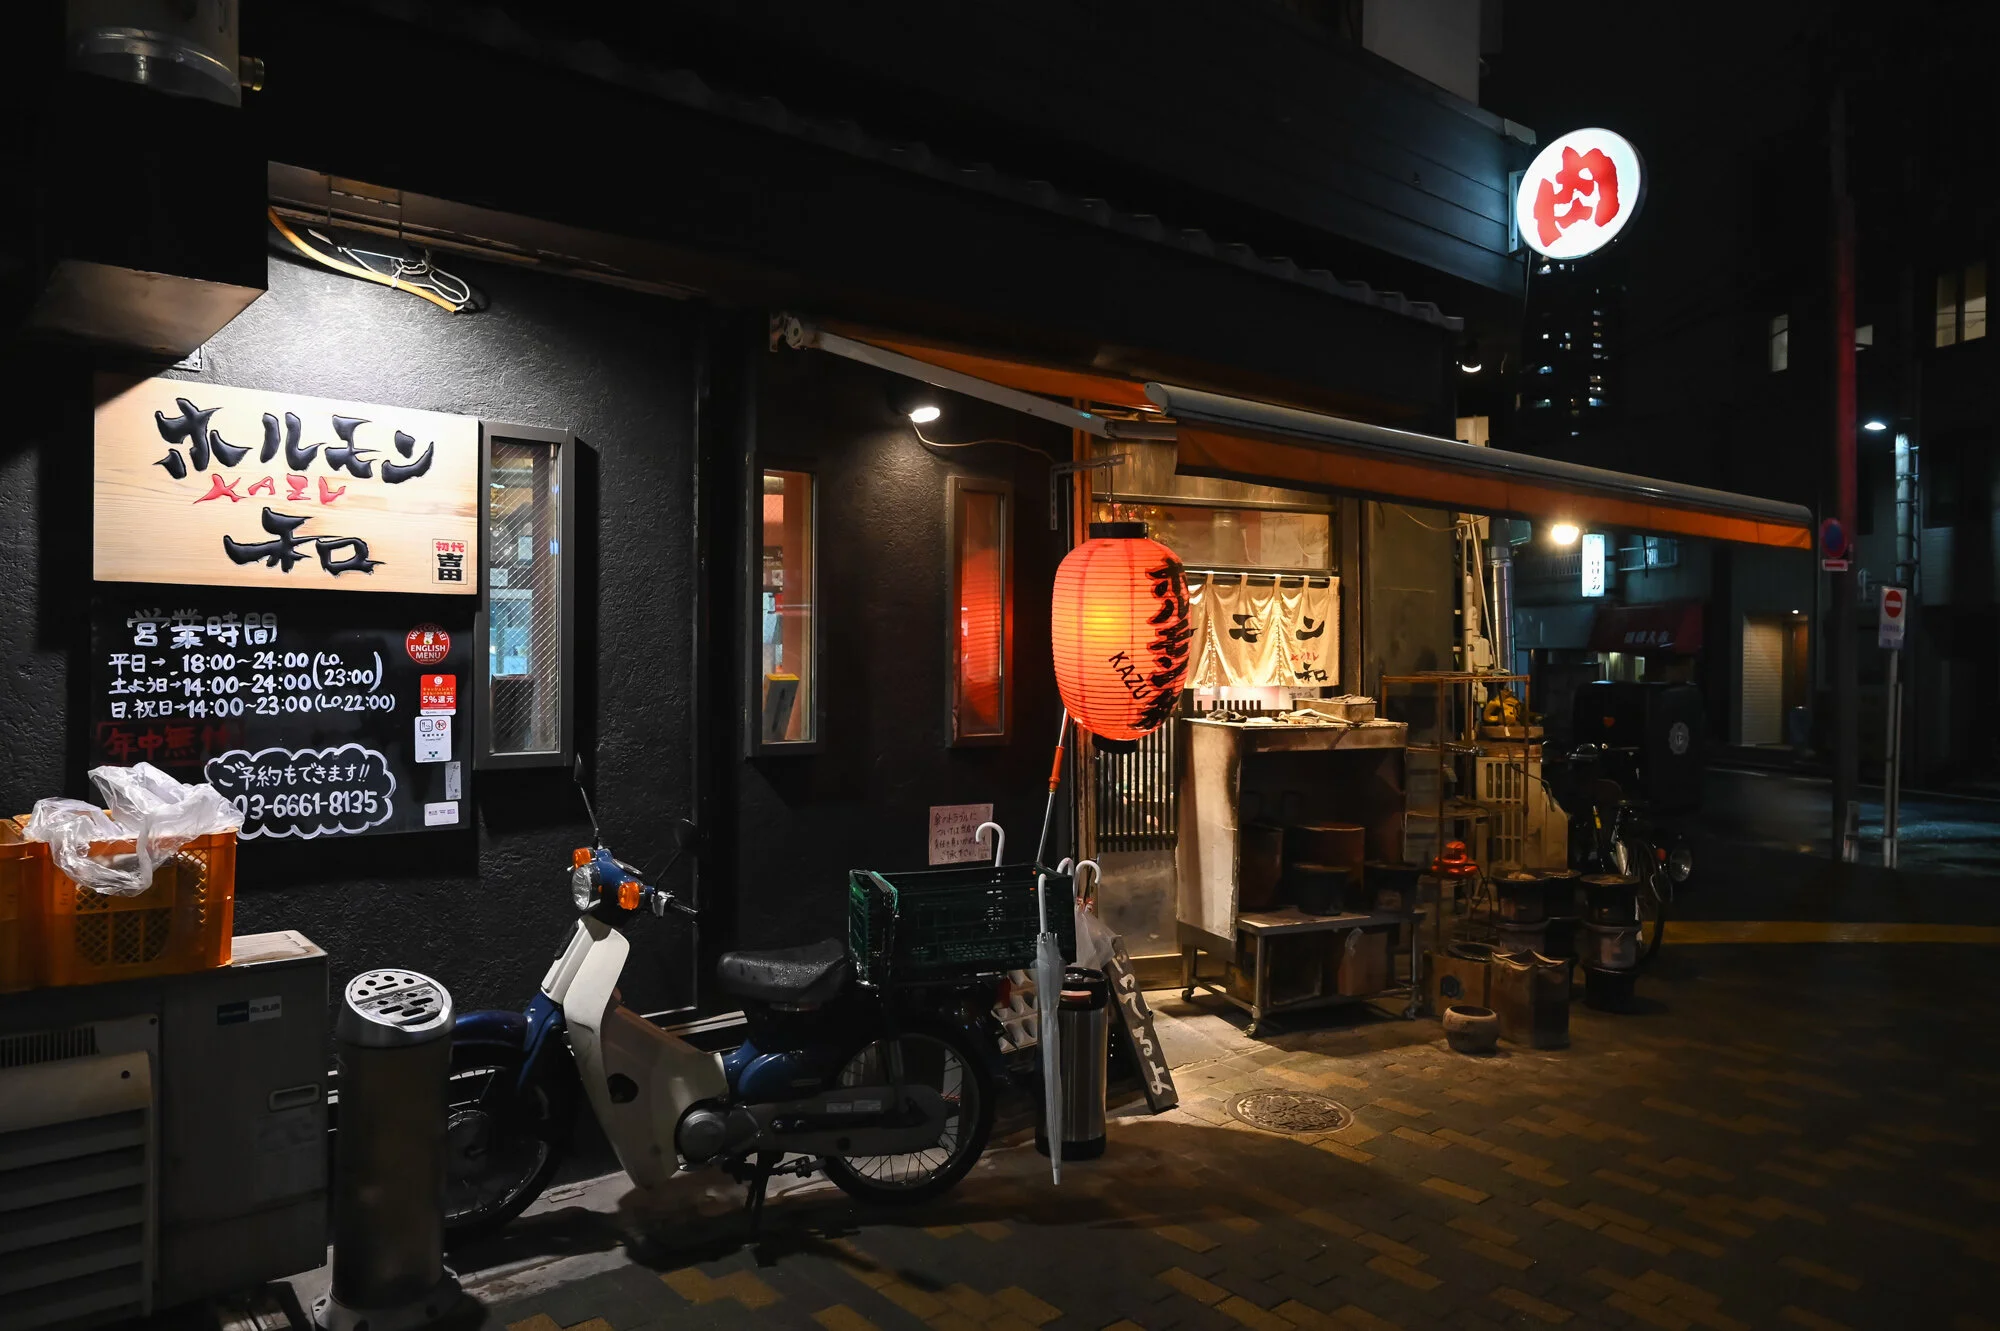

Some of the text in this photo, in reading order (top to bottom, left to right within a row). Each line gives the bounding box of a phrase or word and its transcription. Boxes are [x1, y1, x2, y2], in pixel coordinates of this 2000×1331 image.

[1533, 146, 1620, 247] 肉
[153, 397, 434, 484] ホルモン
[223, 507, 386, 577] 和
[436, 541, 464, 552] 初代
[127, 608, 279, 649] 営業時間
[108, 653, 146, 675] 平日
[410, 644, 446, 652] ENGLISH
[108, 676, 168, 694] 土よう日
[1108, 651, 1152, 700] KAZU
[233, 789, 378, 820] 03-6661-8135
